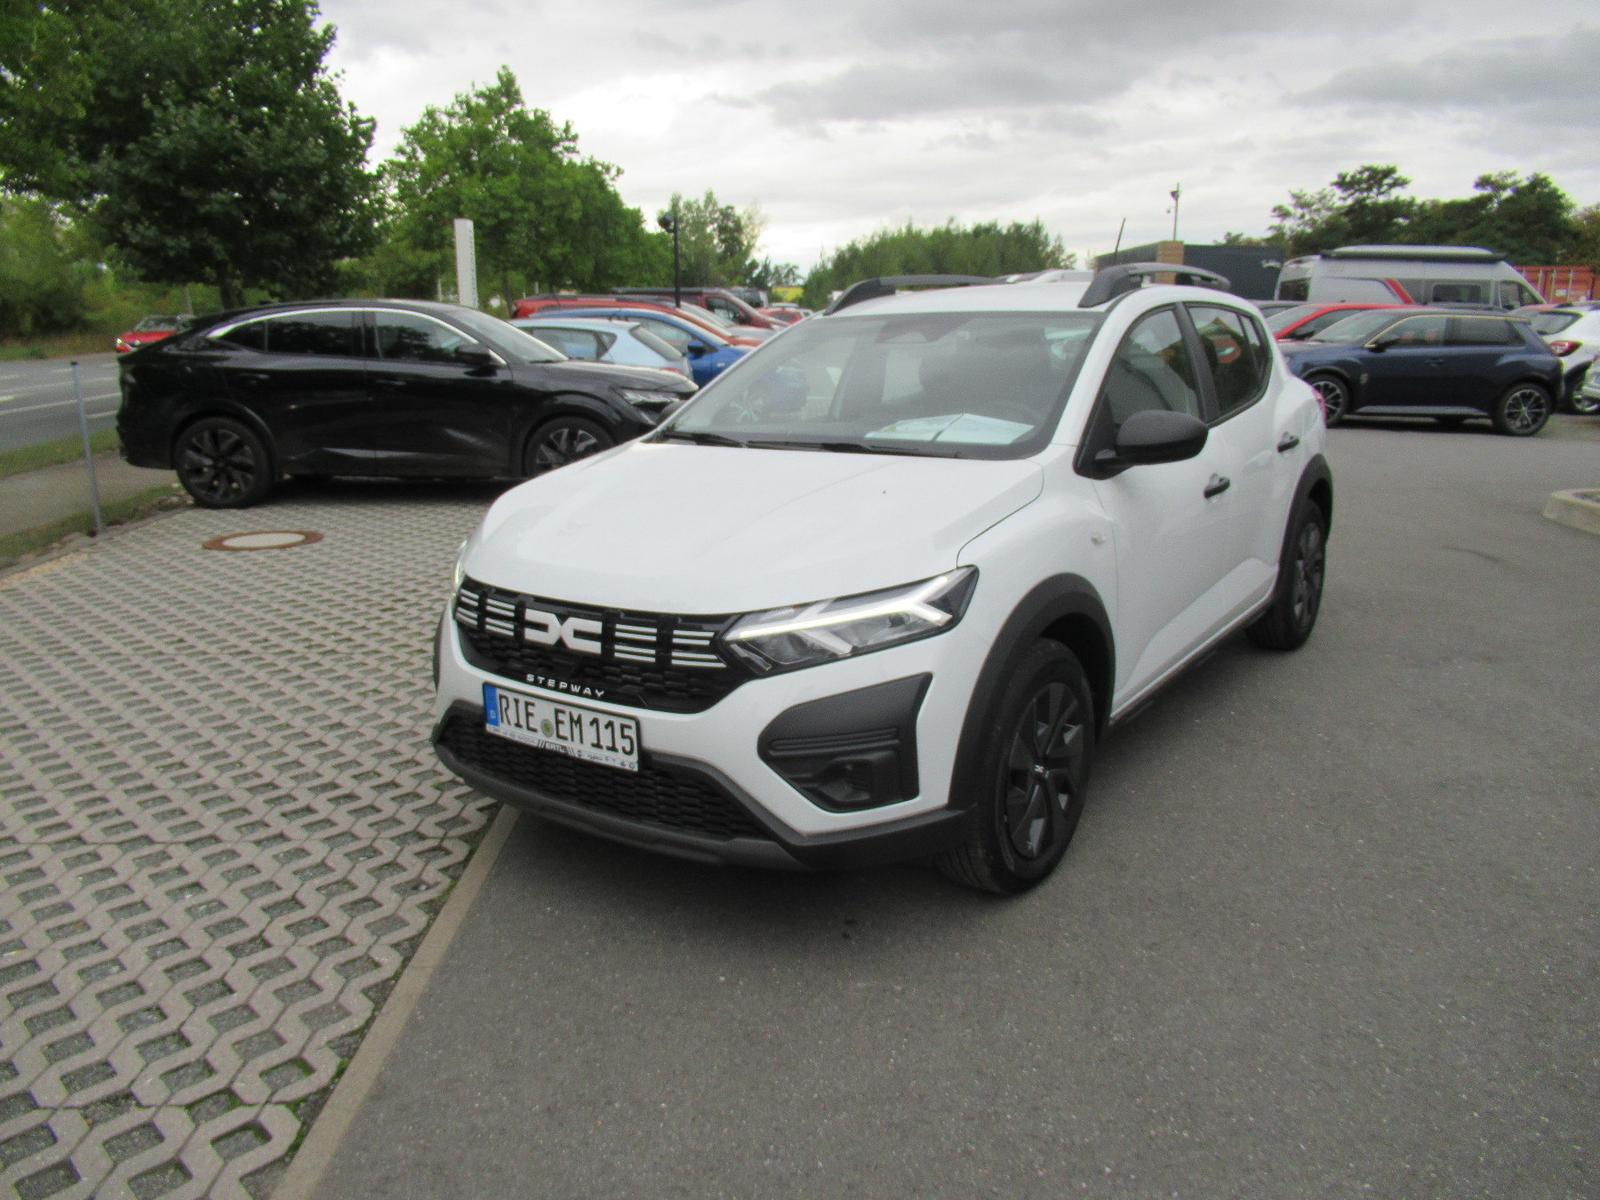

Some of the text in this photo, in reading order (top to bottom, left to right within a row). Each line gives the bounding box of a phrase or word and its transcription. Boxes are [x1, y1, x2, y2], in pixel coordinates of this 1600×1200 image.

[525, 673, 605, 697] STEPWAY
[498, 693, 538, 733] RIE
[554, 708, 584, 744] EM
[590, 717, 635, 756] 115
